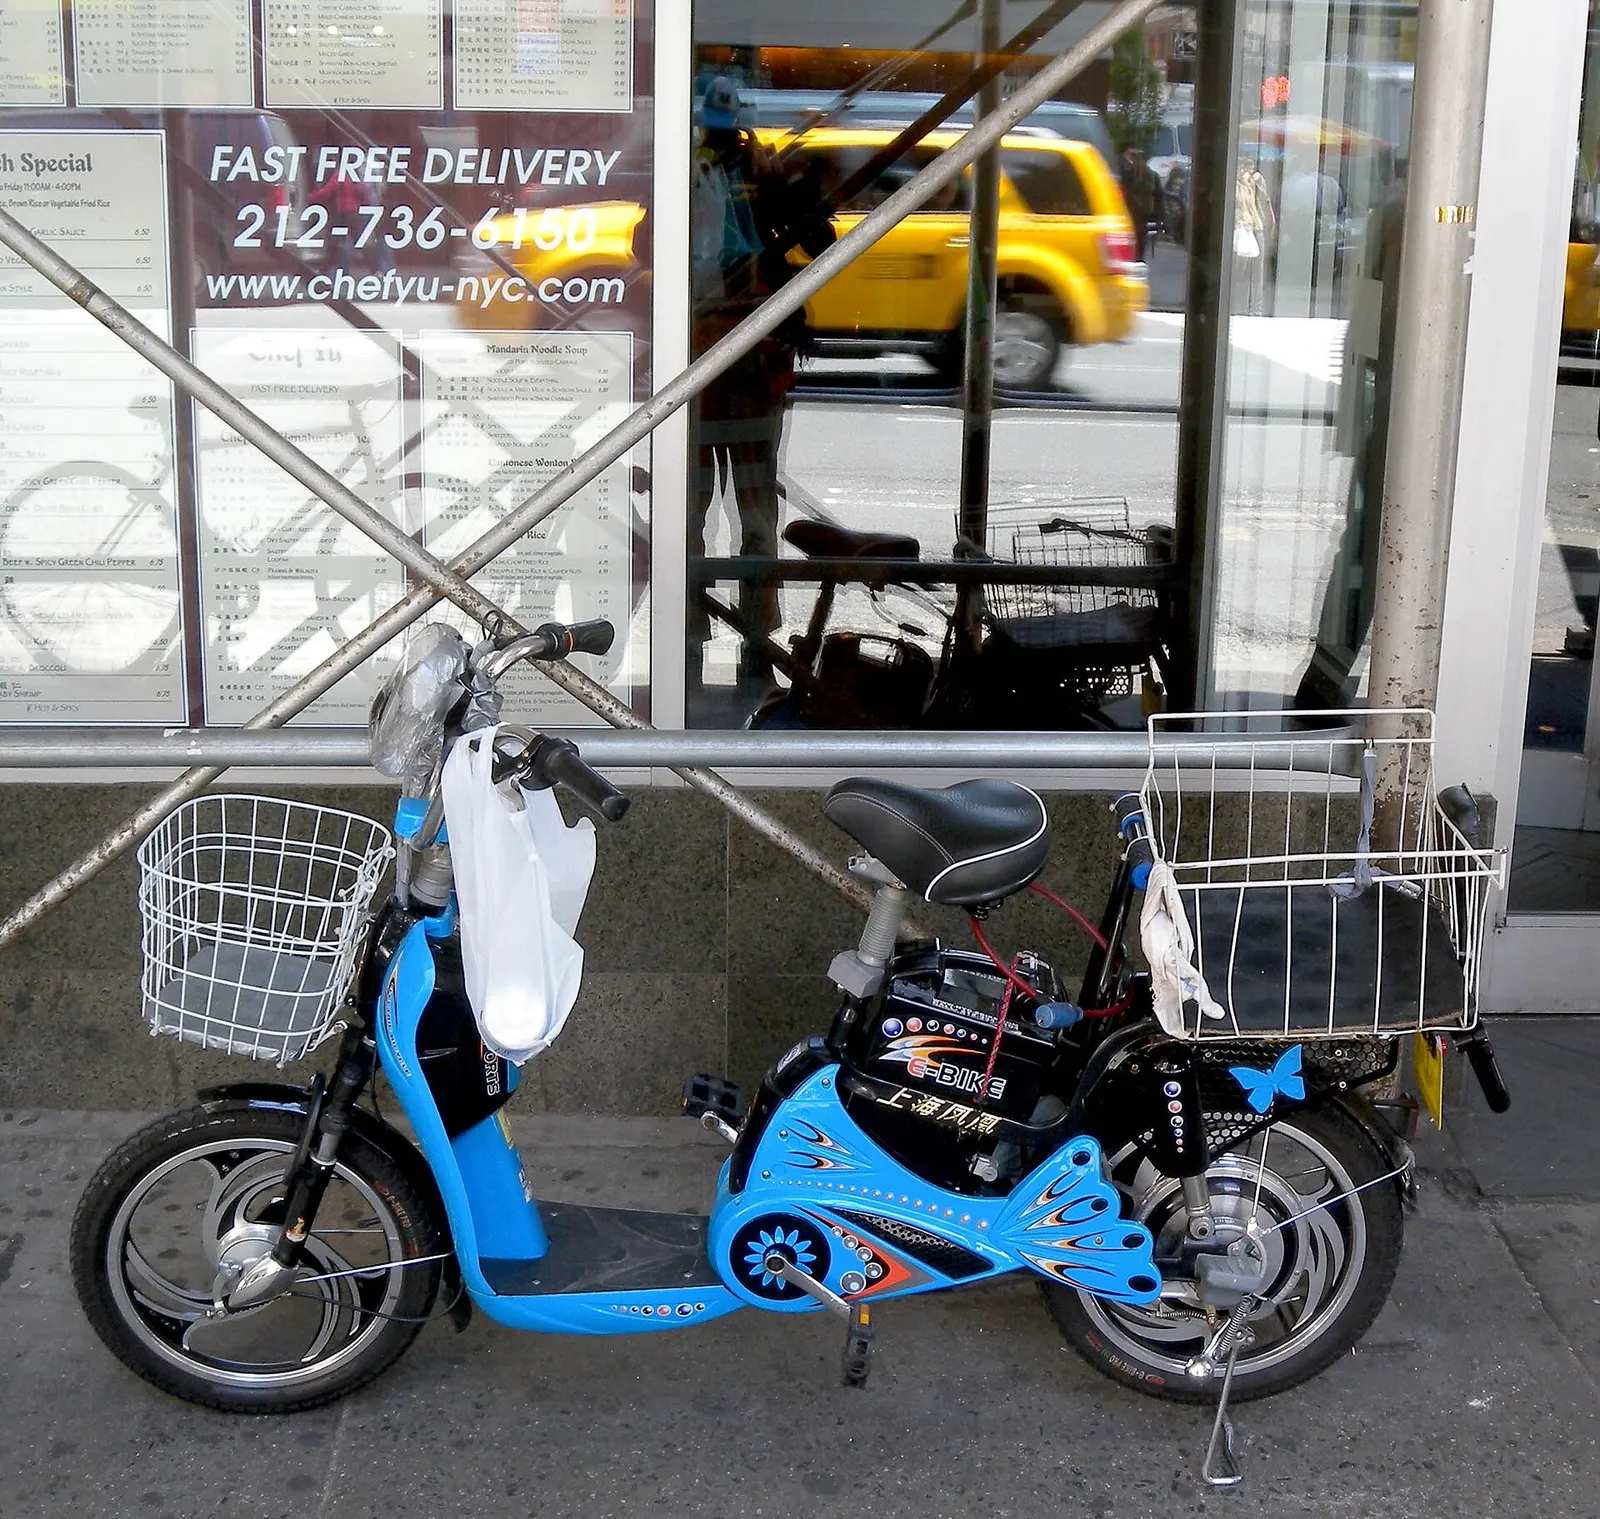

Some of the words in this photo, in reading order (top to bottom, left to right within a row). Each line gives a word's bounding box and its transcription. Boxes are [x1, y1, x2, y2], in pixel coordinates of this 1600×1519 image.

[21, 153, 93, 177] Special
[209, 145, 307, 183] FAST
[316, 146, 411, 184] FREE
[422, 147, 622, 186] DELIVERY
[4, 183, 23, 192] Friday
[9, 199, 27, 207] Brown
[28, 199, 42, 207] Rice
[50, 199, 80, 209] Vegetable
[80, 199, 96, 207] Fried
[97, 199, 111, 207] Rice
[30, 227, 58, 236] GARLIC
[59, 227, 86, 236] SAUCE
[134, 228, 150, 236] 6.50
[232, 203, 599, 251] 212-736-6150
[136, 256, 151, 264] 6.50
[8, 284, 33, 292] STYLE
[205, 267, 626, 308] www.chefyu-nyc.com
[486, 345, 528, 356] Mandarin
[531, 345, 562, 356] Noodle
[565, 345, 588, 356] Soup
[251, 385, 271, 394] FAST
[274, 385, 296, 394] FREE
[298, 385, 340, 394] DELIVERY
[141, 396, 157, 404] 6.50
[528, 530, 546, 539] Rice
[36, 558, 56, 566] SPICY
[58, 558, 84, 566] GREEN
[85, 558, 106, 566] CHILI
[106, 558, 136, 566] PEPPER
[14, 690, 42, 698] SHRIMP
[483, 1050, 500, 1096] ORTS
[906, 1056, 1007, 1100] E-BIKE
